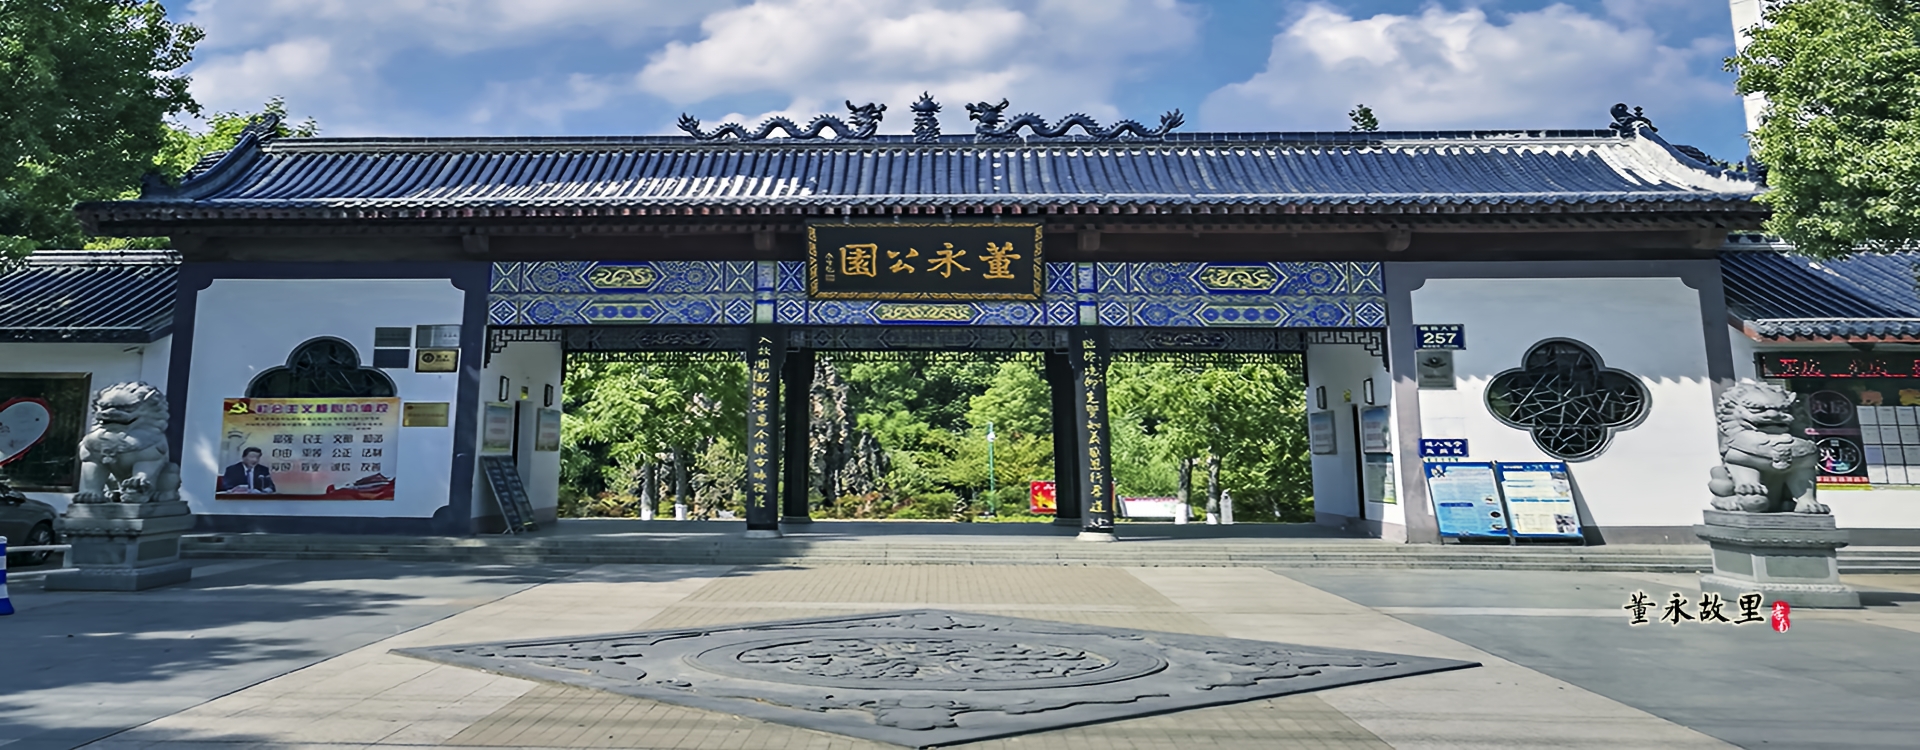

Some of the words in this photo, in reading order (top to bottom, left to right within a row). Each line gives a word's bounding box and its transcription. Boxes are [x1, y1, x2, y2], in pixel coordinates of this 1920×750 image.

[1423, 332, 1457, 344] 257
[272, 448, 292, 458] 自由
[332, 448, 352, 458] 公正
